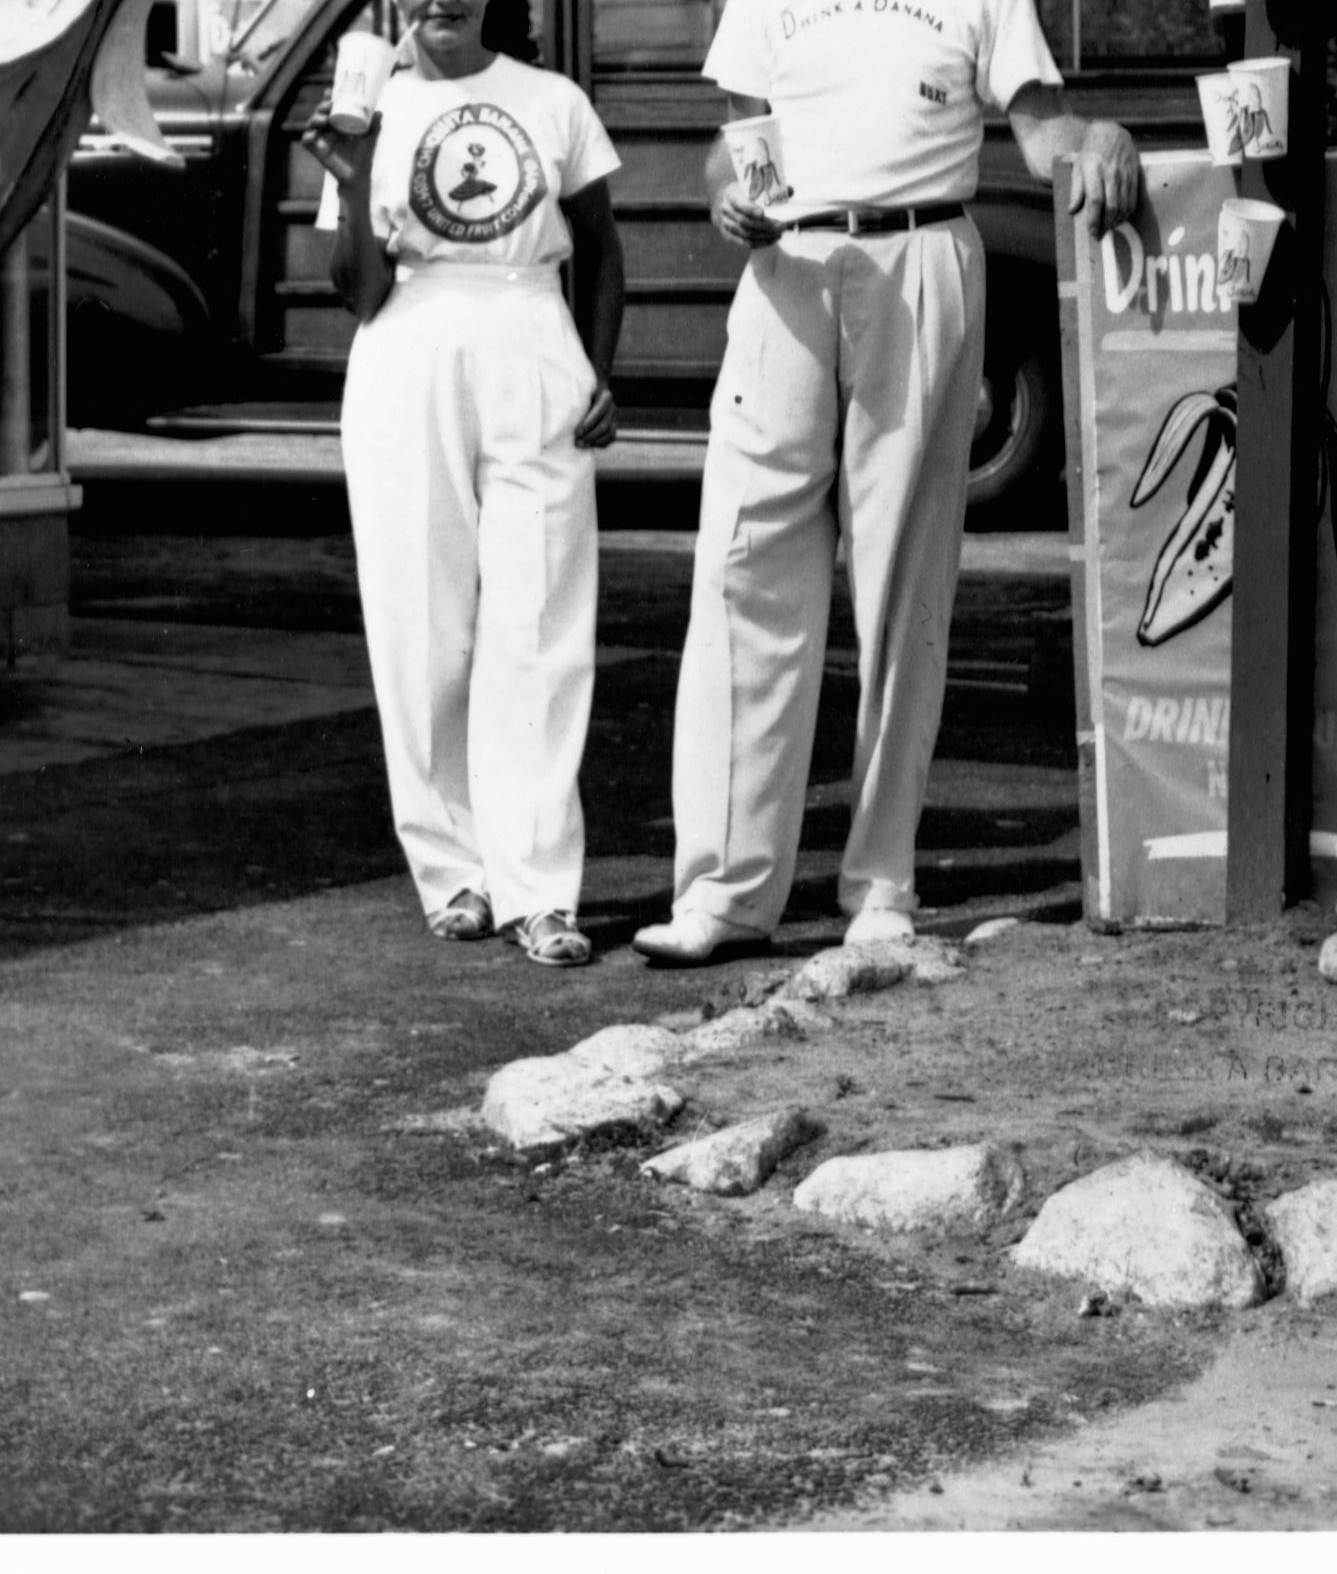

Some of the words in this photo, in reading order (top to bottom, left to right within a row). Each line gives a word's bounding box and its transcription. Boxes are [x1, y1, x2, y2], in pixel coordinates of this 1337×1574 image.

[854, 0, 864, 11] A
[1101, 221, 1233, 314] Drin
[1123, 696, 1231, 745] DRIN
